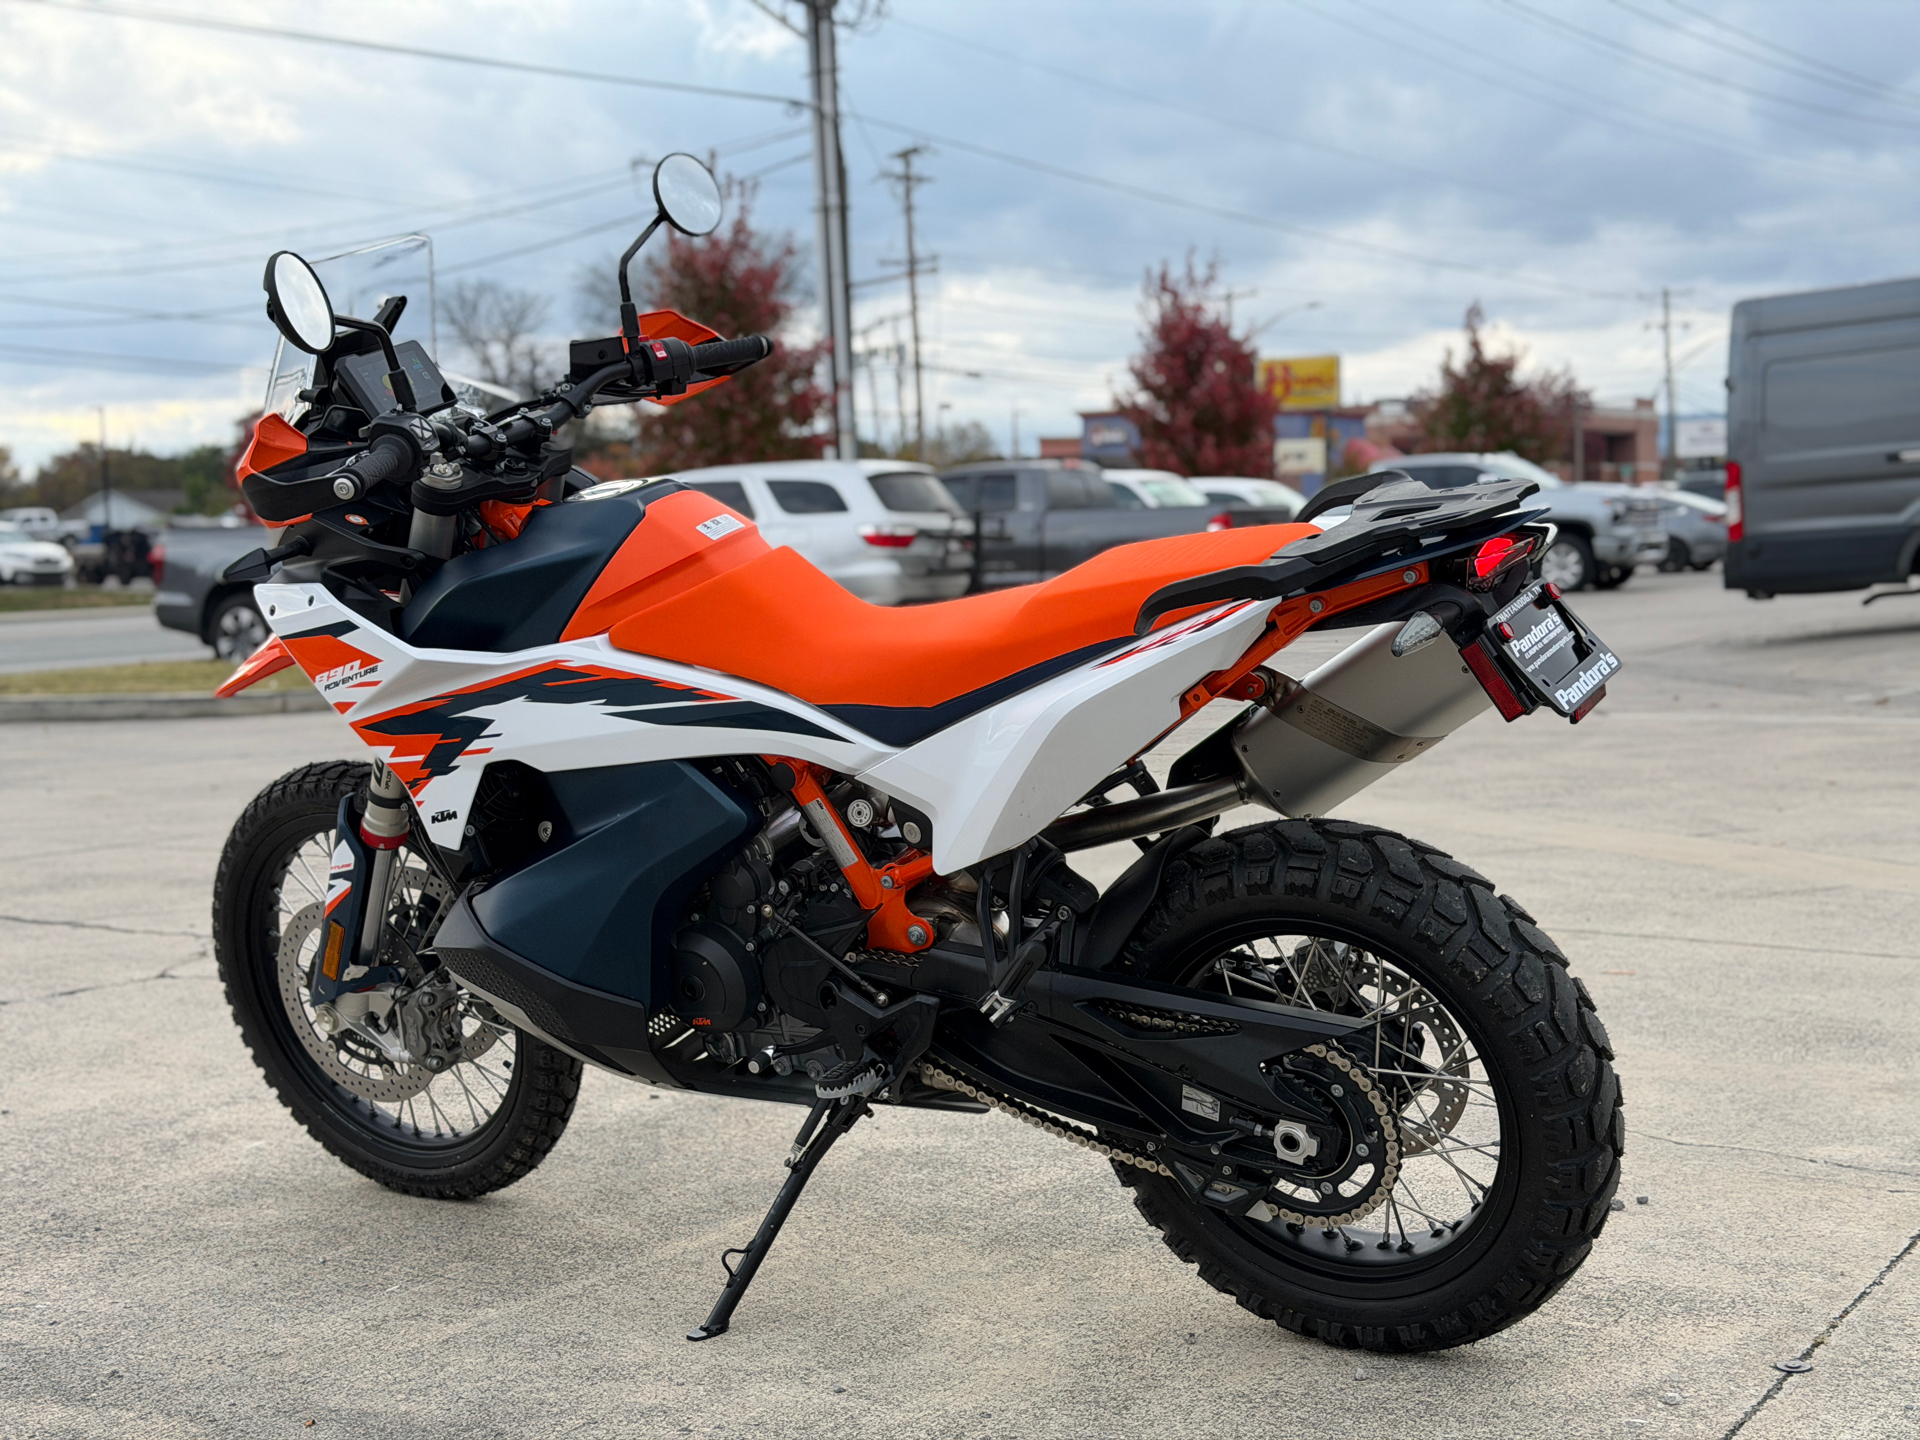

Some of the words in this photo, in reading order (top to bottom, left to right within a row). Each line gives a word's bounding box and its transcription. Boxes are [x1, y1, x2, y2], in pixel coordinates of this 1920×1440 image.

[1496, 592, 1534, 622] CHATTANOOGA
[1532, 585, 1542, 595] TN
[1510, 612, 1561, 658] Pandora's
[1524, 641, 1543, 659] EUROPEAN
[1542, 625, 1565, 645] MOTORSPORTS
[314, 659, 361, 684] 890
[324, 665, 379, 691] ADVENTURE
[1554, 652, 1618, 711] Pandora's
[431, 809, 458, 824] KTM
[692, 1017, 712, 1026] KTM
